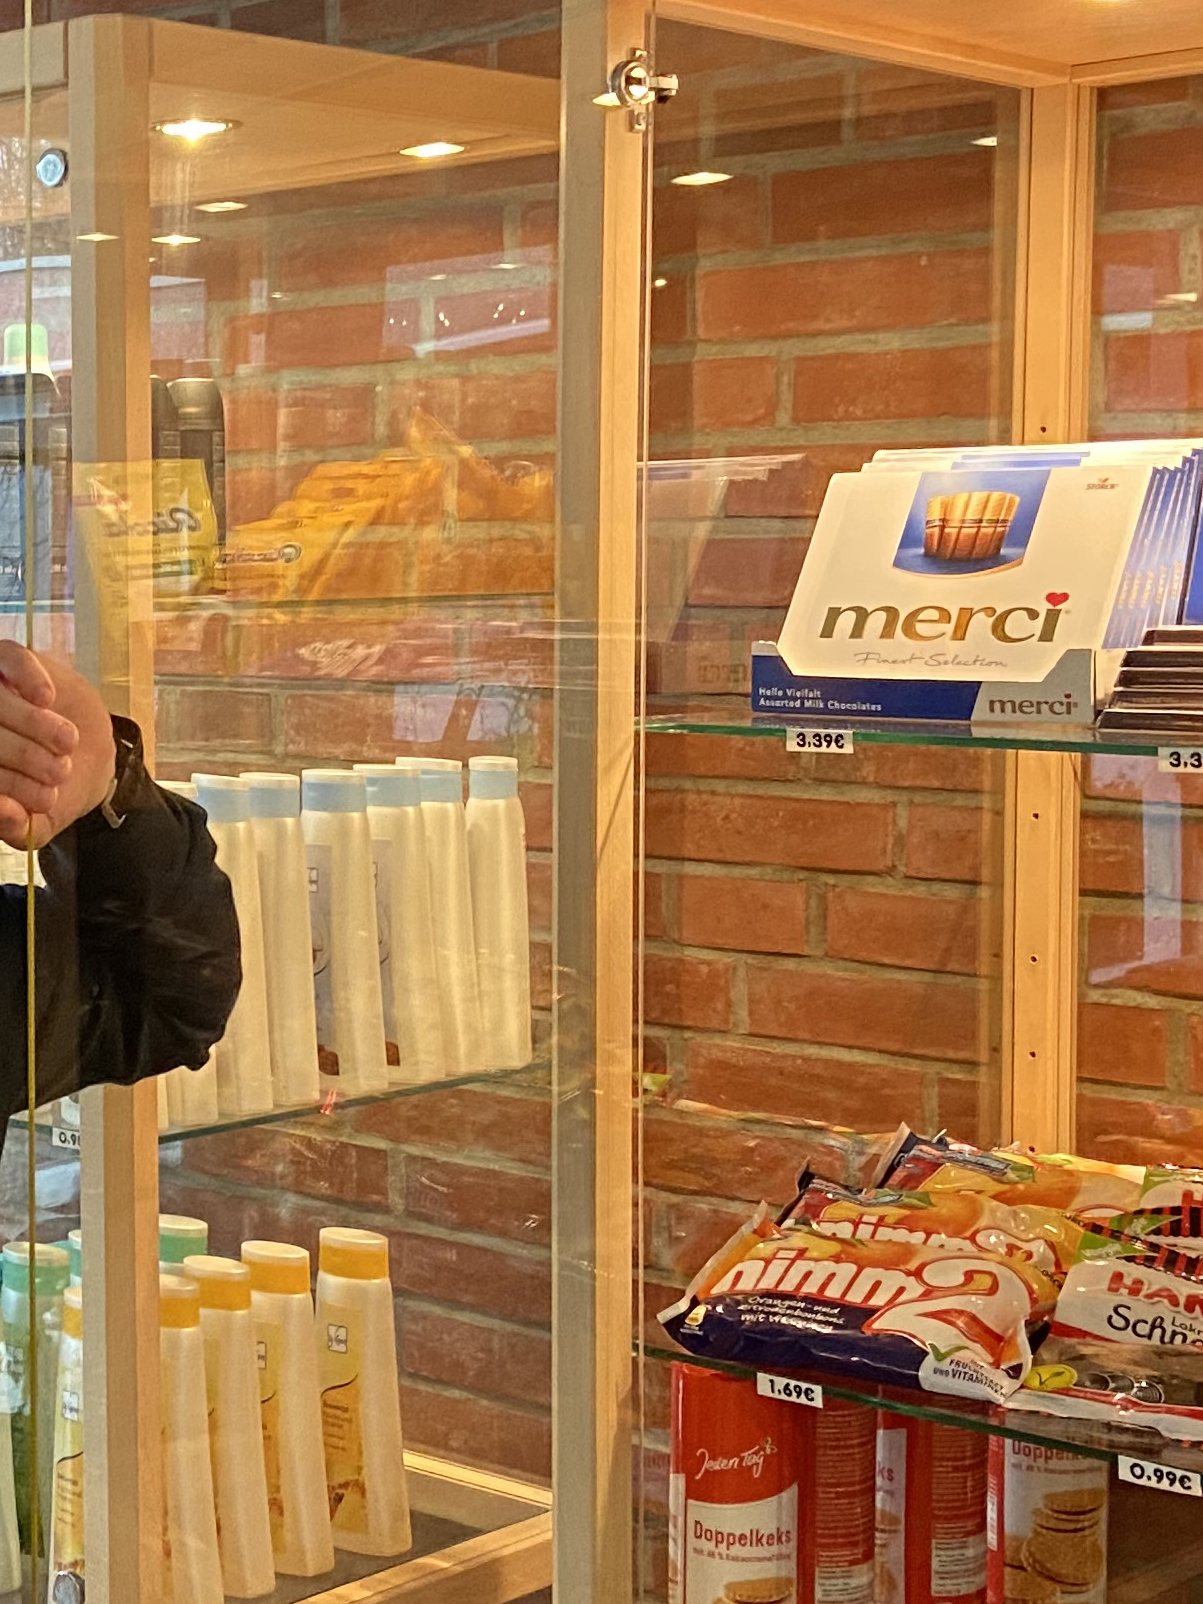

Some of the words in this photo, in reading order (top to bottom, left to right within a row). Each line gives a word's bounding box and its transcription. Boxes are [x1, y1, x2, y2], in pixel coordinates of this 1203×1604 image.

[818, 592, 1069, 643] merci
[803, 699, 824, 709] Milk
[828, 700, 882, 711] Chocolates
[989, 693, 1072, 716] merci
[740, 1445, 765, 1478] Tag
[693, 1519, 792, 1551] Doppelkeks
